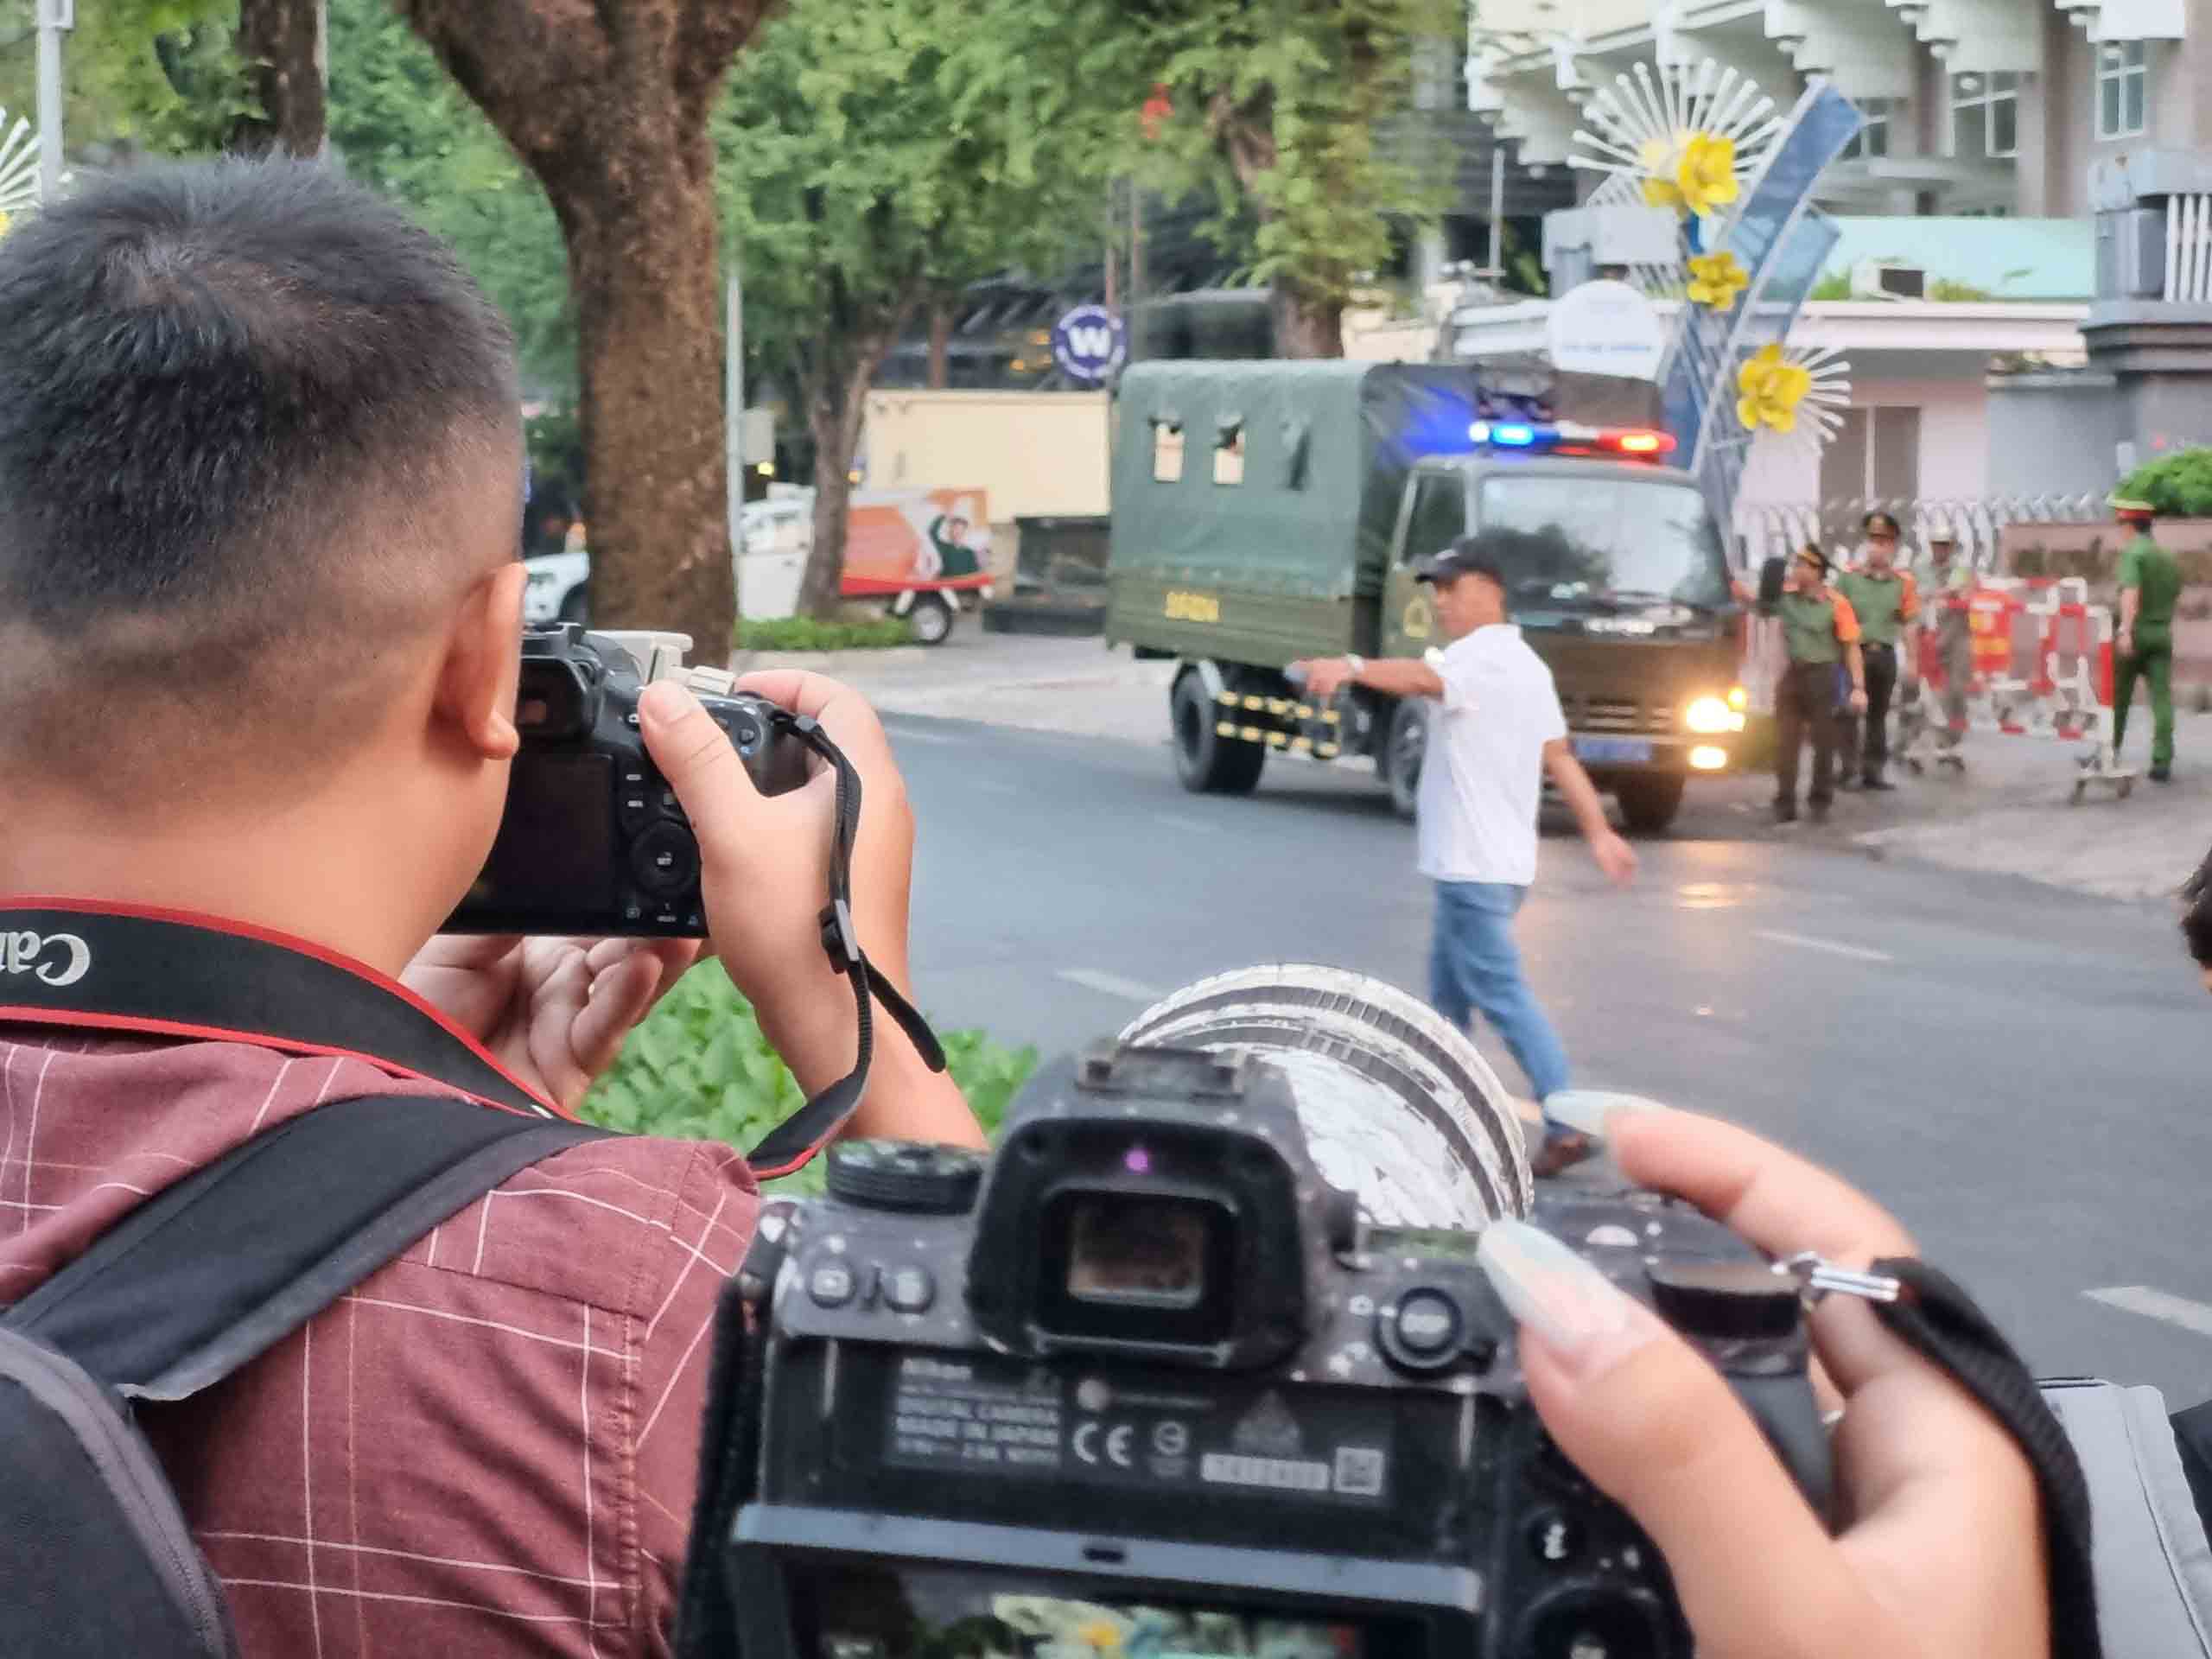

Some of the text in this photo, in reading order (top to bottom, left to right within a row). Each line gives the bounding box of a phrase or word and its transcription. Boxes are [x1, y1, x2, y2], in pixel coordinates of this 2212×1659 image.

[1068, 326, 1111, 358] W
[0, 930, 91, 987] Ca
[1073, 1421, 1133, 1466] CE
